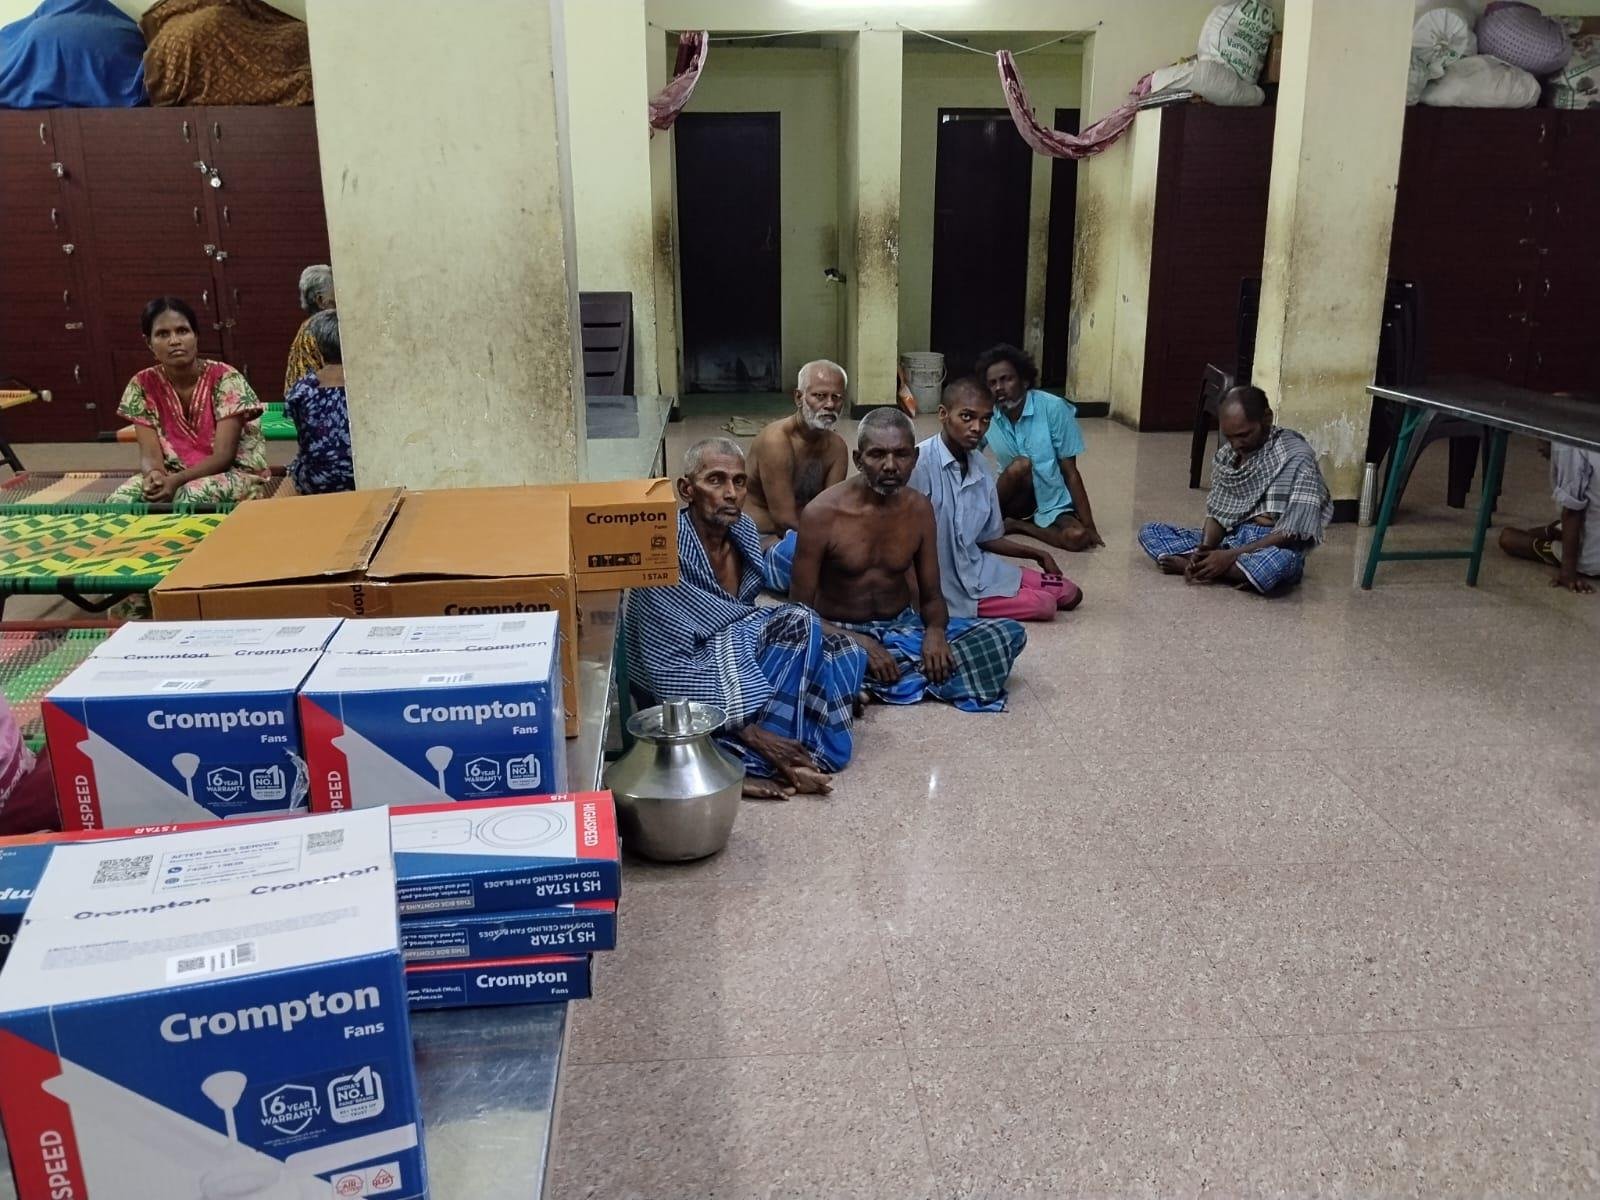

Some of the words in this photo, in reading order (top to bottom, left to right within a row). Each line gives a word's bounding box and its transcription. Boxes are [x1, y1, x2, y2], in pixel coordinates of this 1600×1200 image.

[586, 512, 666, 525] Crompton
[350, 584, 366, 615] pton
[444, 602, 550, 616] Crompton
[234, 646, 320, 657] Crompton
[465, 640, 547, 652] Crompton
[147, 708, 284, 732] Crompton
[403, 701, 536, 725] Crompton
[512, 725, 538, 735] Fans
[261, 734, 287, 744] Fans
[471, 764, 480, 776] 6
[522, 754, 535, 774] 1
[213, 773, 223, 786] 6
[266, 765, 279, 785] 1
[75, 775, 95, 831] HSPEED
[583, 803, 598, 847] HIGHSPEED
[250, 866, 379, 896] Crompton
[483, 879, 513, 889] BLADES
[533, 874, 564, 882] CEILING
[583, 880, 601, 892] HS
[536, 883, 570, 896] STAR
[574, 882, 580, 893] 1
[74, 898, 211, 920] Crompton
[531, 933, 565, 946] STAR
[577, 931, 596, 942] HS
[476, 971, 567, 988] Crompton
[160, 987, 380, 1042] Crompton
[344, 1021, 385, 1039] Fans
[337, 1090, 363, 1102] NO.
[352, 1066, 374, 1096] 1
[270, 1095, 286, 1115] 6
[287, 1101, 311, 1112] YEAR
[261, 1106, 322, 1127] WARRANTY
[40, 1130, 73, 1200] SPEED
